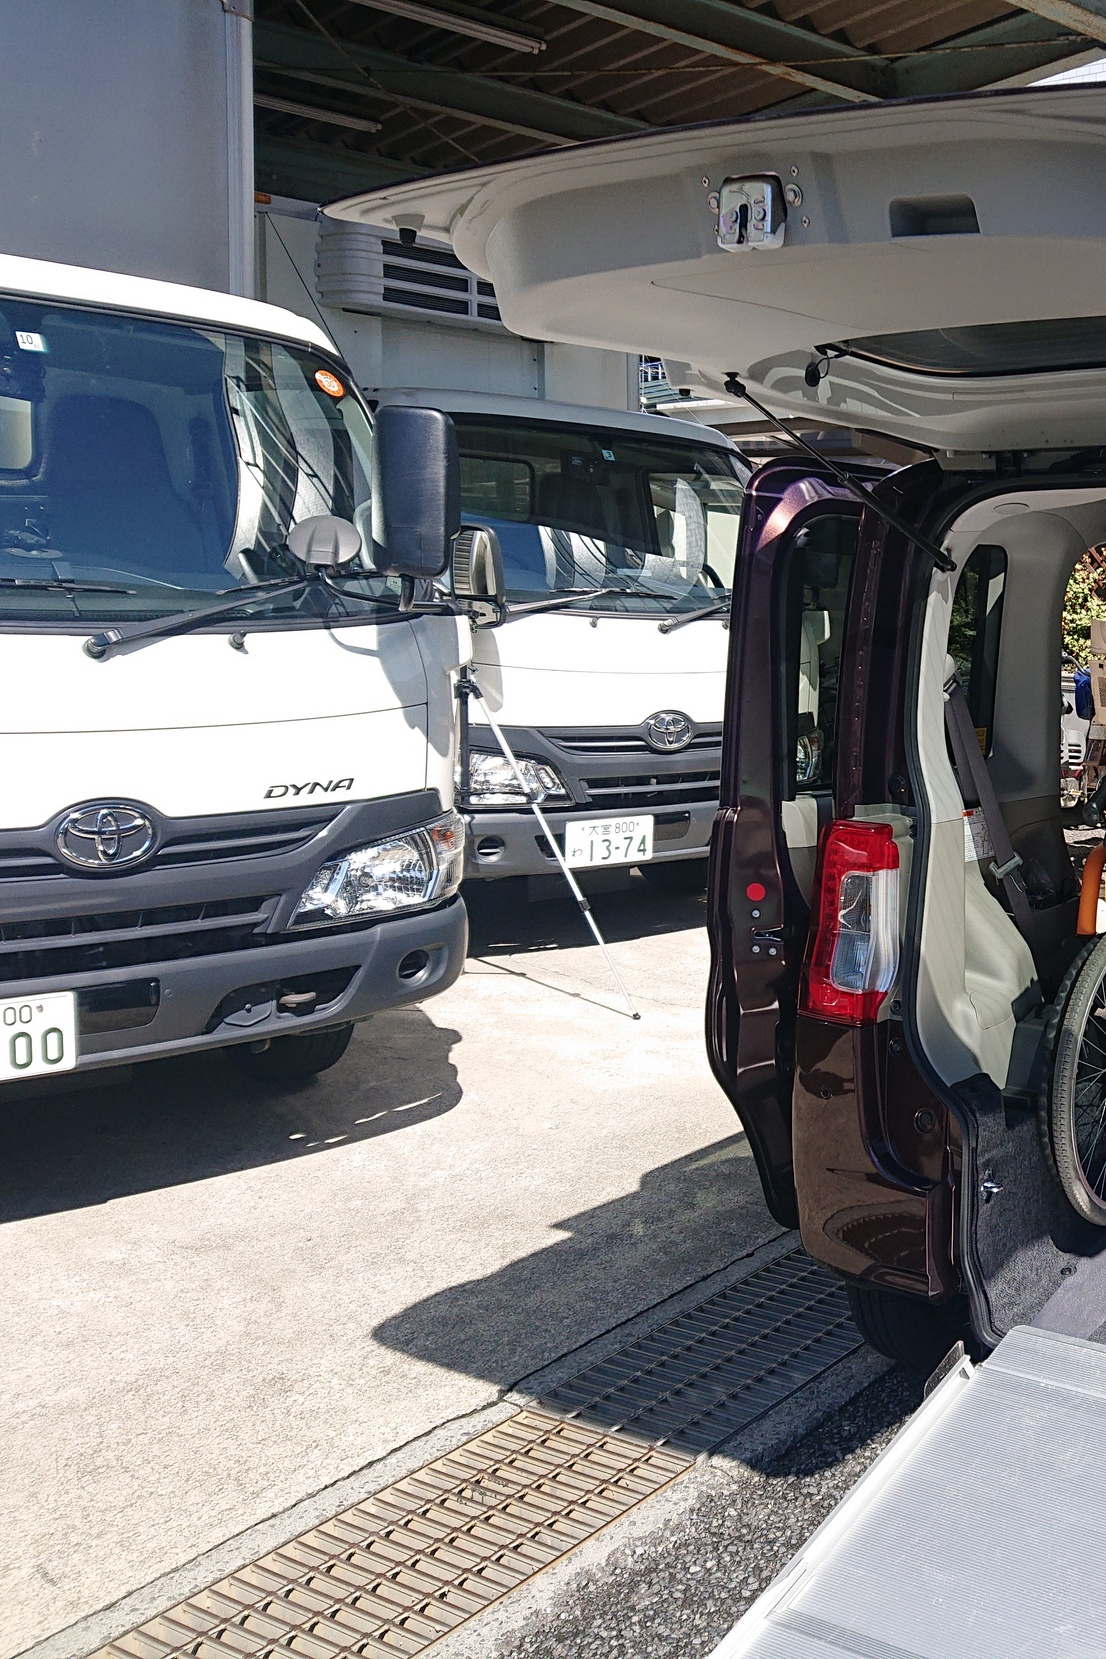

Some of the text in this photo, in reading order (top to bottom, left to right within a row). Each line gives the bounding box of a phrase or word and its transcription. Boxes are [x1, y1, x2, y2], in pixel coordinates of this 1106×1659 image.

[19, 334, 34, 345] 10
[263, 777, 355, 799] DYNA
[571, 834, 648, 862] わ 13-74
[3, 1004, 33, 1026] 00
[8, 1027, 65, 1070] 00
